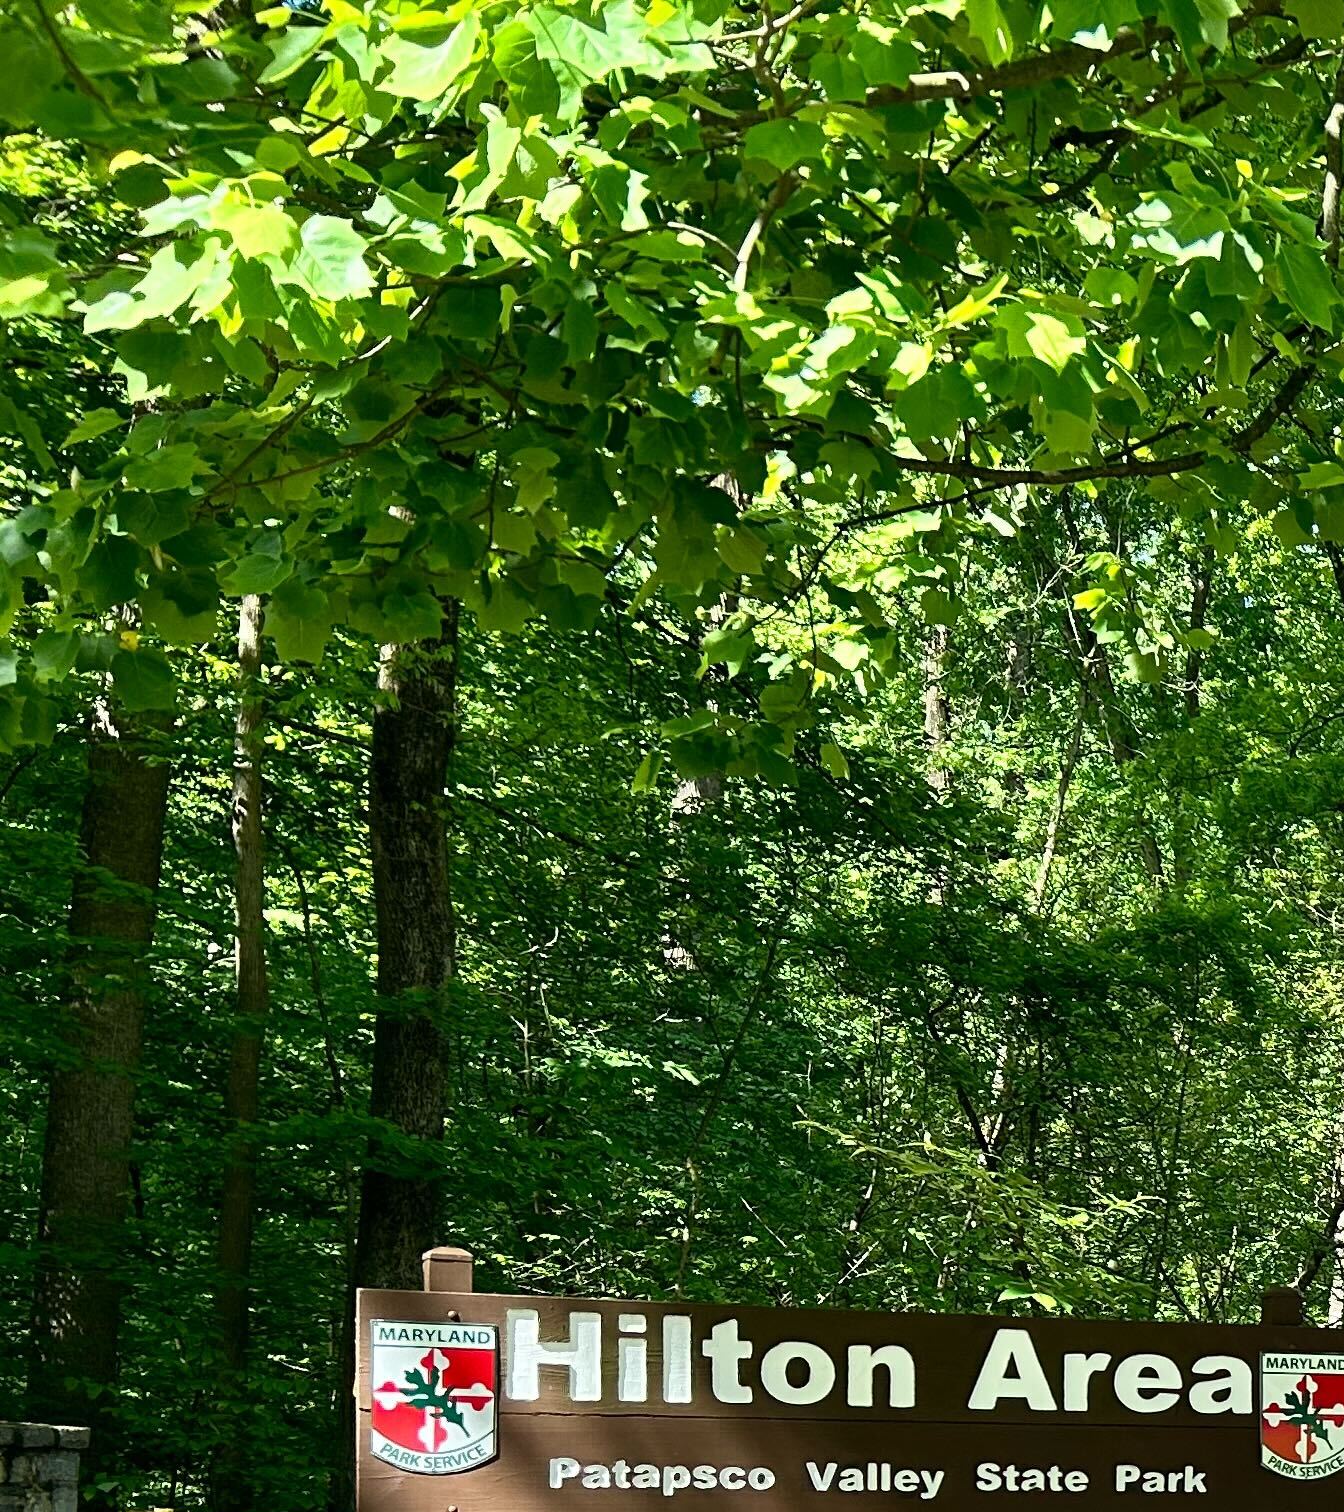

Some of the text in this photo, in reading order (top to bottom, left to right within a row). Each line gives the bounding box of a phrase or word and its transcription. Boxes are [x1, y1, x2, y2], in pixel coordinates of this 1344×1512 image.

[379, 1326, 491, 1346] MARYLAND
[506, 1308, 1253, 1415] Hilton Area
[380, 1443, 488, 1470] PARK SERVICE
[1267, 1455, 1344, 1478] PARK SERVICE
[549, 1457, 1208, 1499] Patapsco Valley State Park
